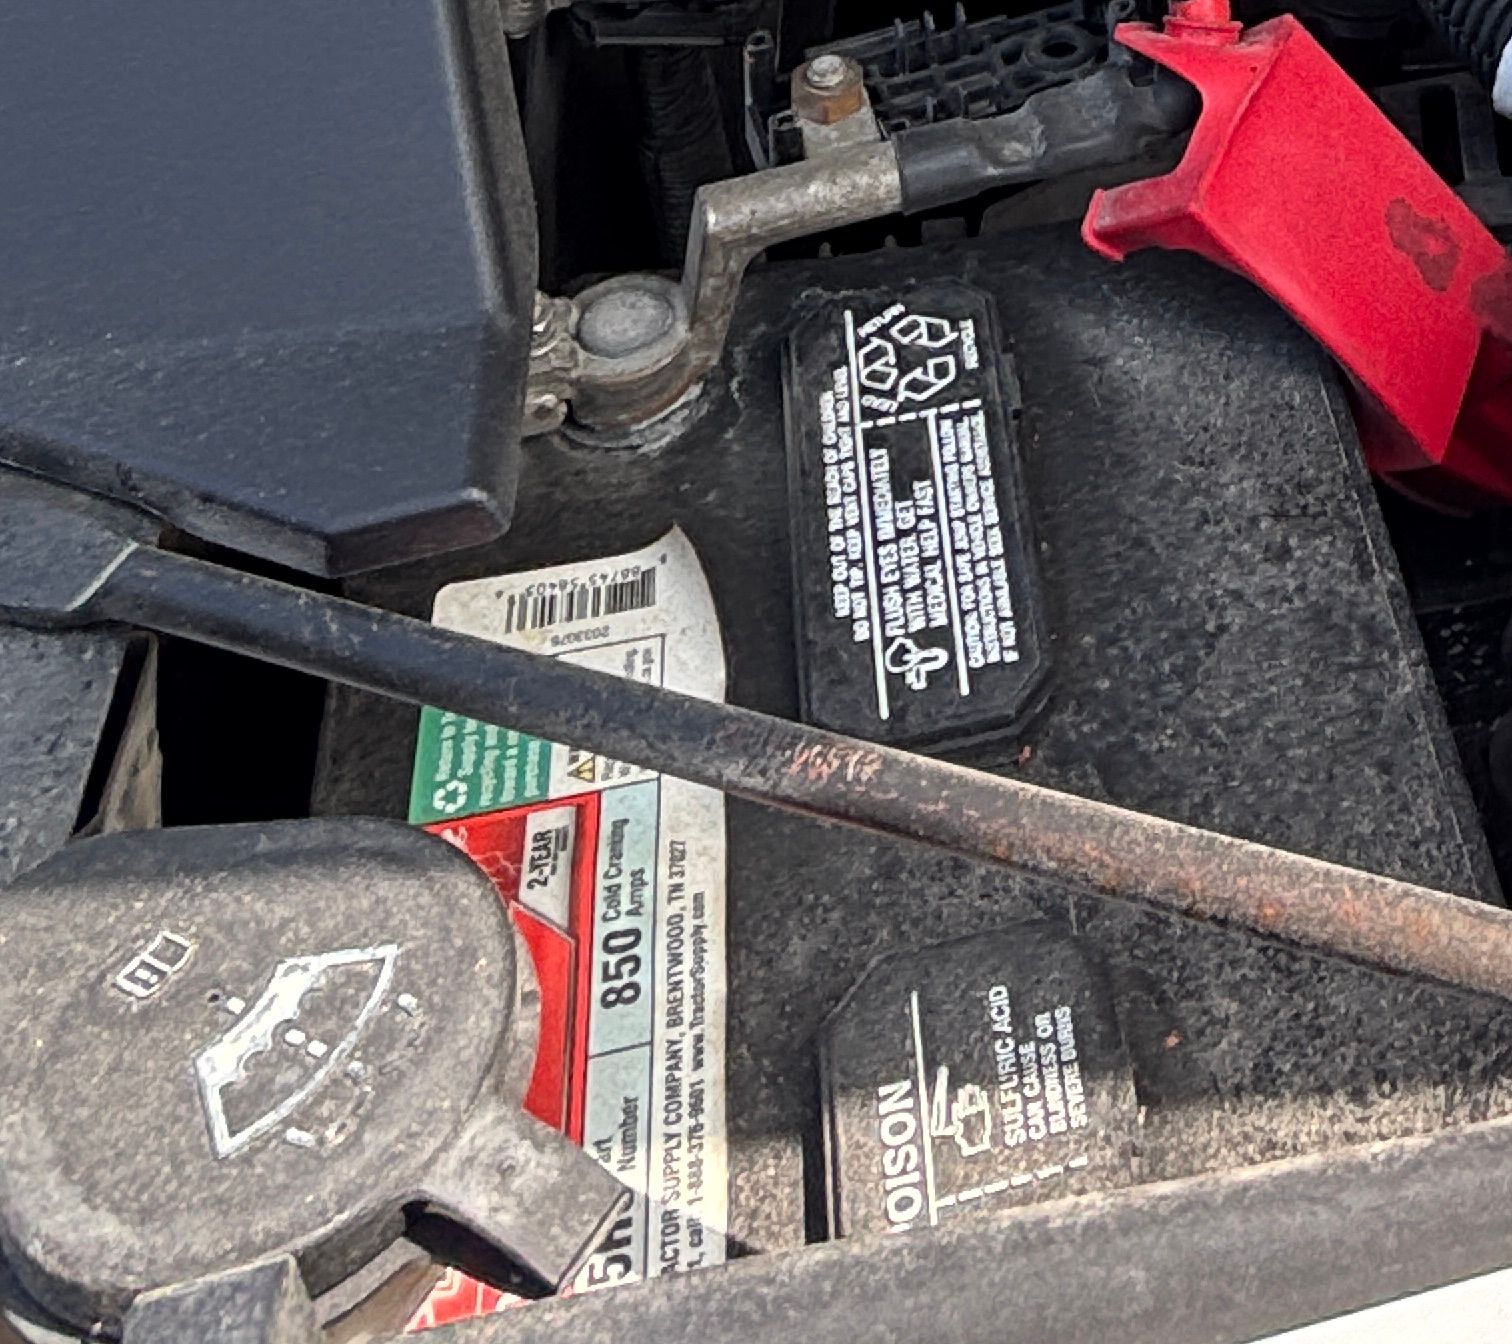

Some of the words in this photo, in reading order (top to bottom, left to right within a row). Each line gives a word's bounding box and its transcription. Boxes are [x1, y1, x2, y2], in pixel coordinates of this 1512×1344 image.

[869, 448, 895, 541] IMMEDIATELY
[895, 500, 915, 529] GET
[913, 480, 934, 515] FAST
[877, 543, 900, 583] EYES
[917, 519, 939, 557] HELP
[831, 555, 848, 581] OUT
[924, 559, 948, 628] MEDICAL
[851, 592, 868, 617] NOT
[882, 585, 905, 637] FLUSH
[905, 590, 926, 633] WITH
[602, 818, 629, 879] Cranking
[601, 883, 622, 922] Cold
[626, 867, 649, 917] Amps
[667, 883, 685, 904] TN
[600, 928, 642, 1009] 850
[988, 985, 1014, 1034] ACID
[1035, 1011, 1053, 1039] OR
[1055, 1005, 1078, 1061] BURNS
[662, 1032, 684, 1126] COMPANY,
[994, 1038, 1027, 1147] SULFURIC
[1019, 1041, 1041, 1097] CAUSE
[1039, 1042, 1068, 1134] BLINDNESS
[1027, 1101, 1047, 1140] CAN
[1065, 1062, 1088, 1129] SEVERE
[592, 1137, 612, 1164] art
[617, 1096, 638, 1172] Number
[878, 1079, 922, 1233] OISON
[662, 1132, 682, 1207] SUPPLY
[659, 1209, 680, 1275] ACTOR
